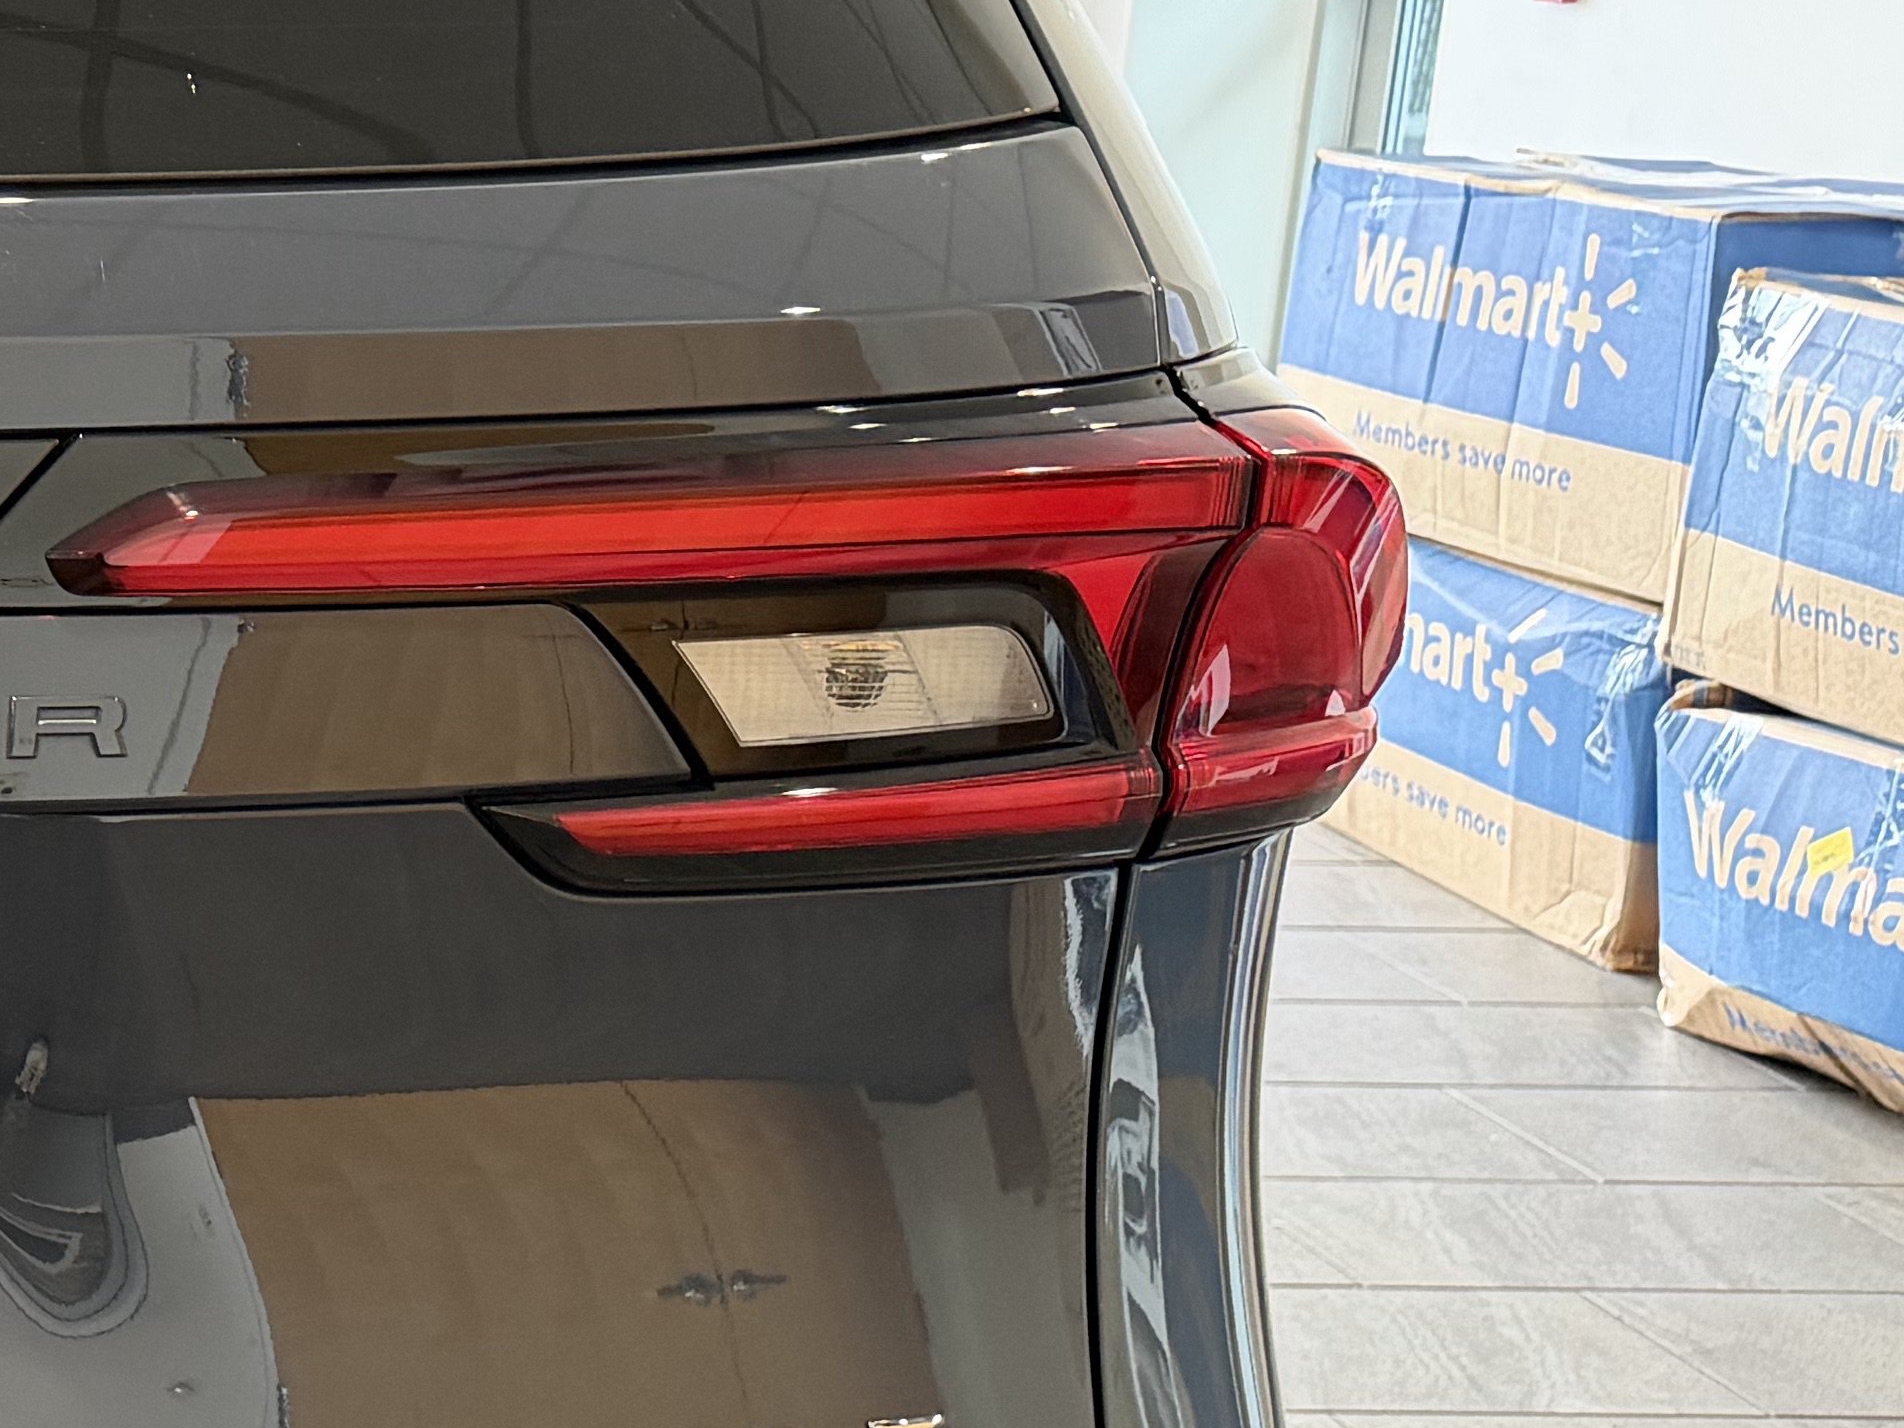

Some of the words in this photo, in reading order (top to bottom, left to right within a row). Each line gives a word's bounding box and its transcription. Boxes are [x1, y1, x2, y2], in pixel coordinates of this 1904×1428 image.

[1352, 410, 1451, 461] Members
[1458, 442, 1506, 476] save
[1511, 457, 1572, 493] more
[1770, 582, 1900, 656] Members
[1406, 780, 1450, 820] save
[1455, 803, 1508, 846] more
